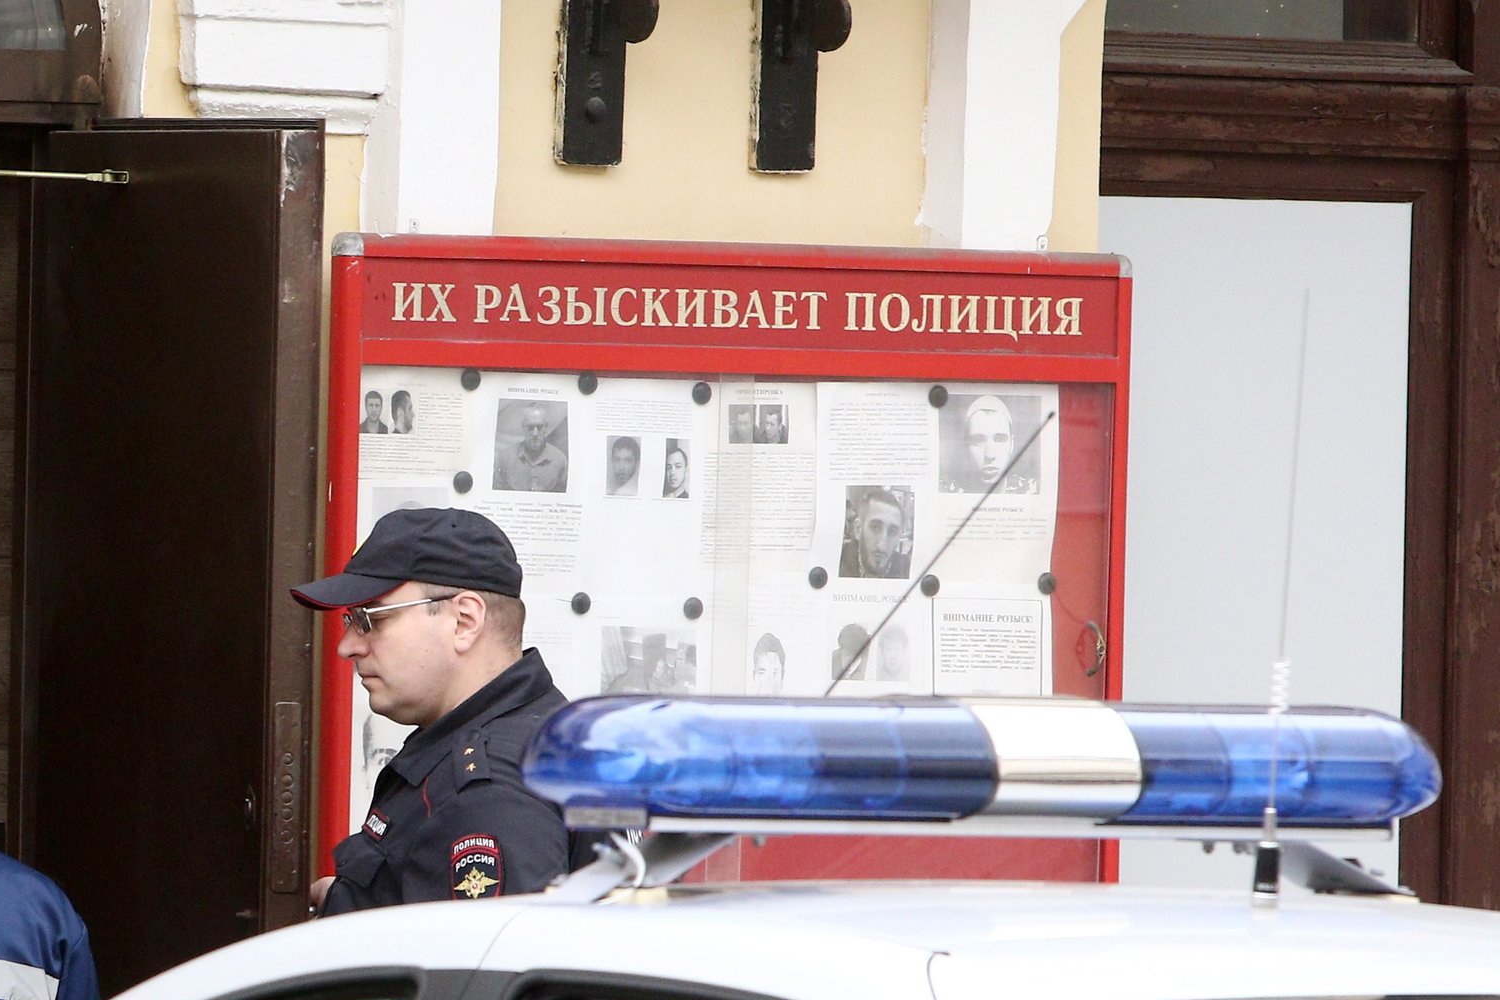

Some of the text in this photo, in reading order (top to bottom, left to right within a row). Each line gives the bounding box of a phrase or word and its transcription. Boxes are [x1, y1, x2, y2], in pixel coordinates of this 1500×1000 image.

[391, 281, 1084, 343] ИХ РАЗЫСКИВАЕТ ПОЛИЦИЯ
[453, 837, 495, 855] ПОЛИЦИЯ
[455, 853, 495, 872] РОССИЯ
